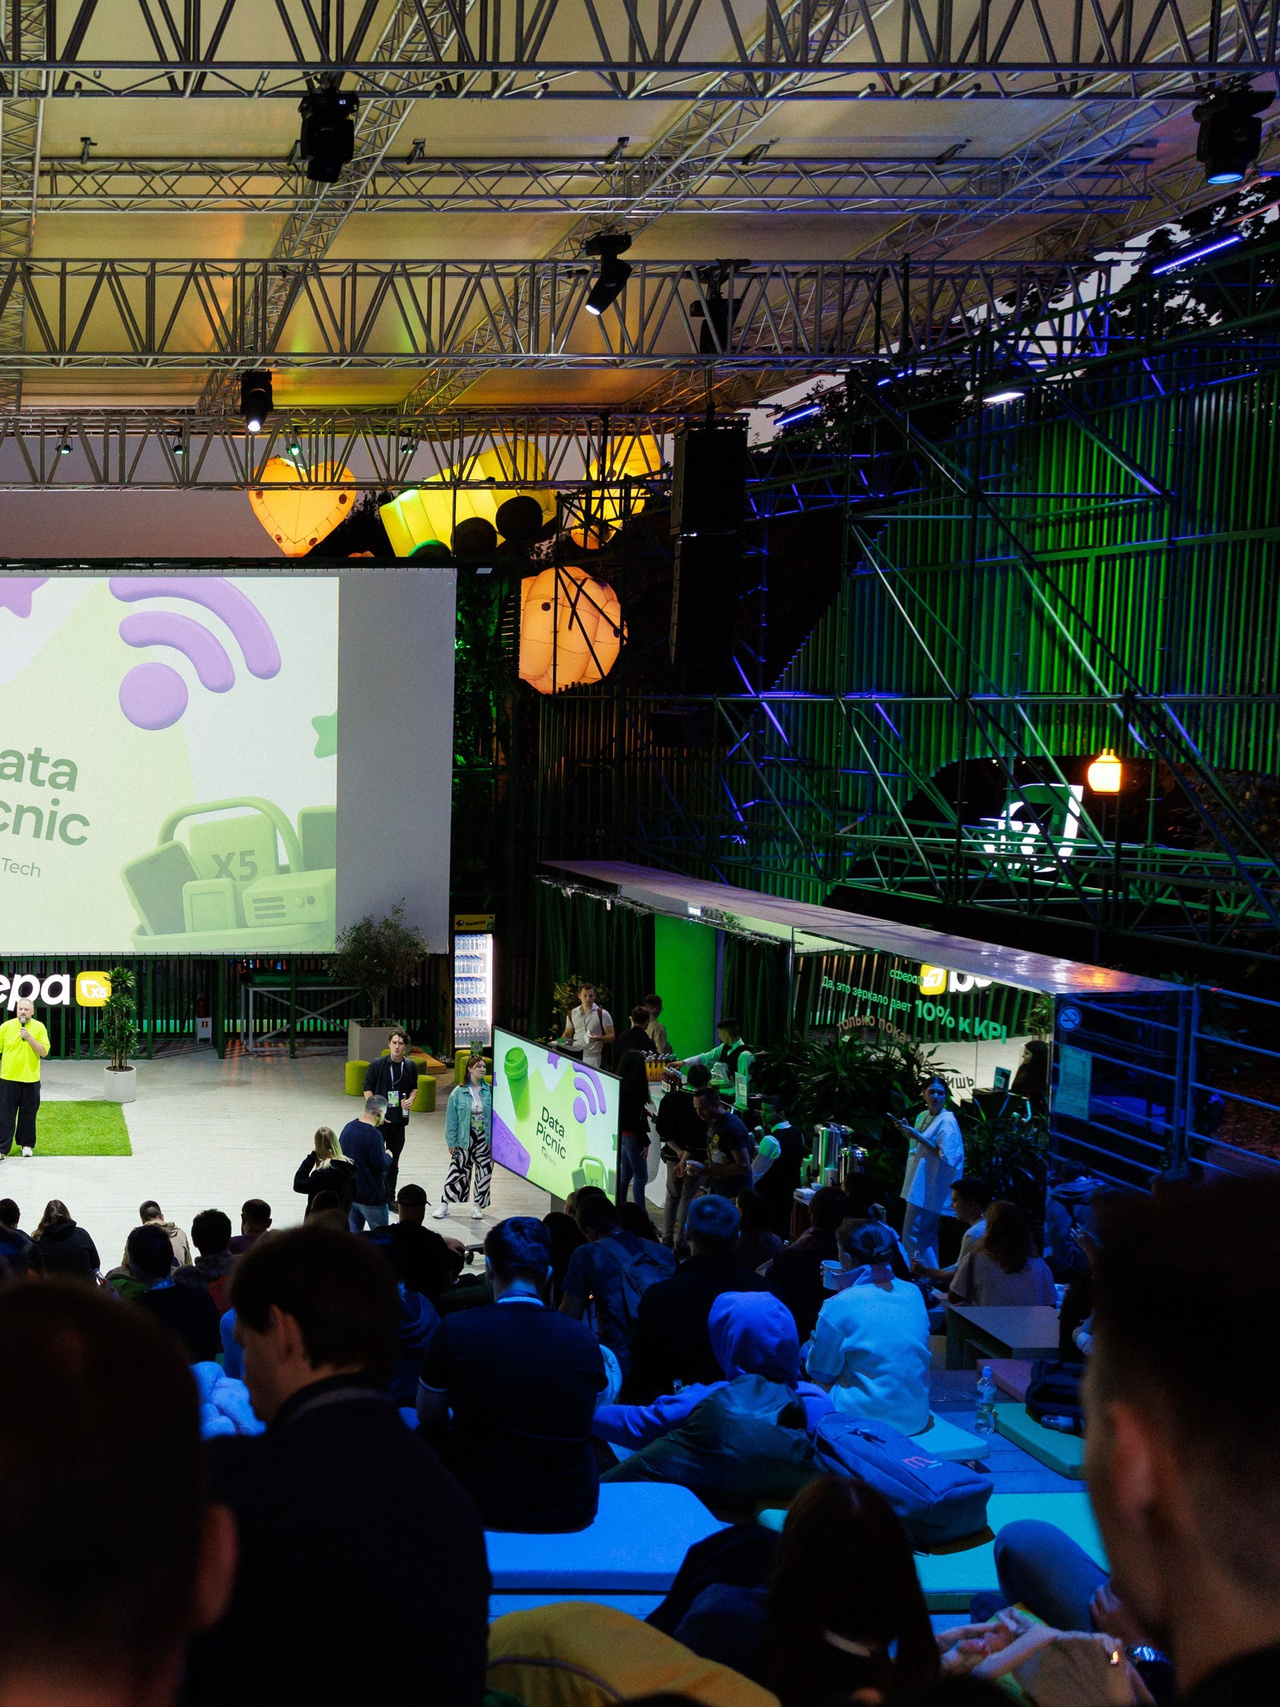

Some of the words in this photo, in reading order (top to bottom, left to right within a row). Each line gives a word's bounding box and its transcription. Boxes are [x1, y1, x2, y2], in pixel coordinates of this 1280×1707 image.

[1, 857, 41, 878] Tech
[211, 849, 258, 882] X5
[889, 968, 920, 986] сфера
[822, 976, 835, 991] Да,
[836, 983, 851, 995] это
[851, 986, 889, 1006] зеркало
[890, 998, 912, 1013] дает
[915, 1000, 955, 1029] 10%
[974, 1017, 1007, 1044] KPI
[836, 1015, 876, 1033] только
[878, 1018, 907, 1045] пока
[541, 1106, 565, 1139] Data
[536, 1121, 567, 1159] Picnic
